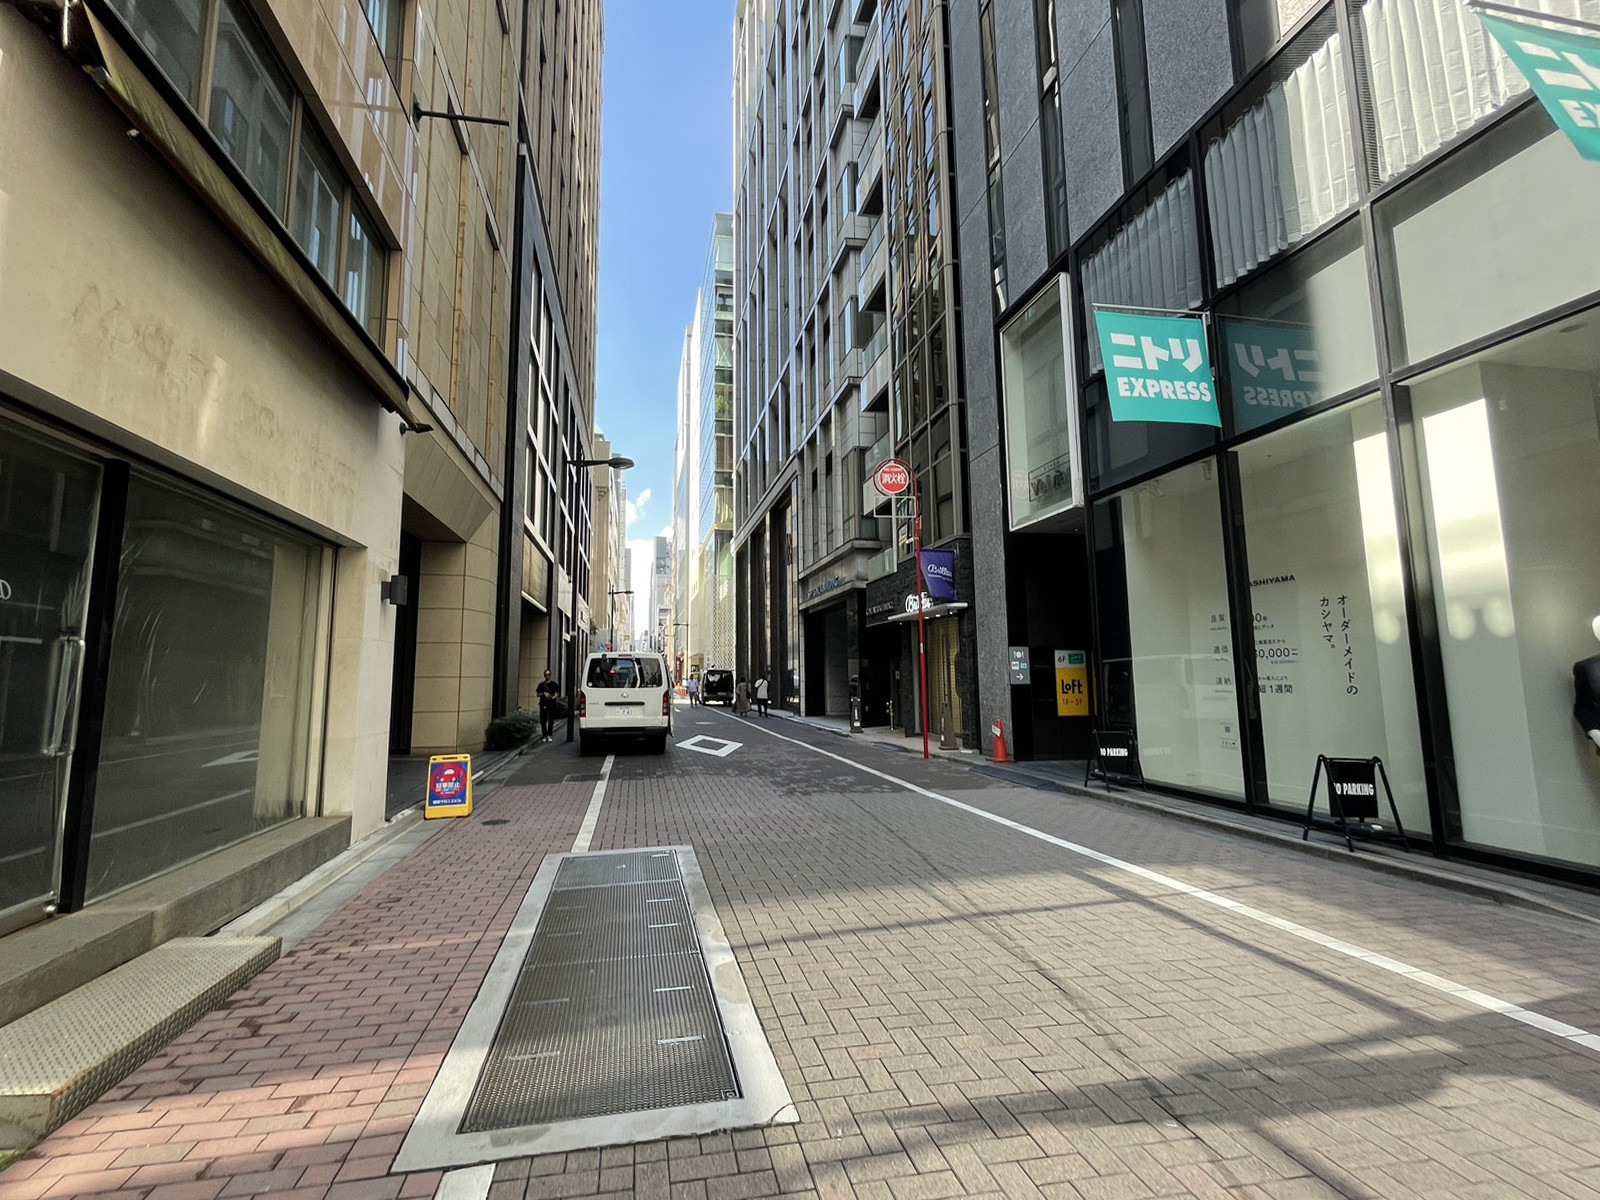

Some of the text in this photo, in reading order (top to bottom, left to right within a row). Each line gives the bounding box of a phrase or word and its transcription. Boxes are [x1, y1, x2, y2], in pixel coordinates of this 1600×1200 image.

[1109, 332, 1204, 374] ニトリ
[1116, 377, 1212, 402] EXPRESS
[881, 472, 906, 484] 消火栓
[1337, 594, 1359, 696] オーダーメイドの
[1343, 782, 1374, 795] PARKING
